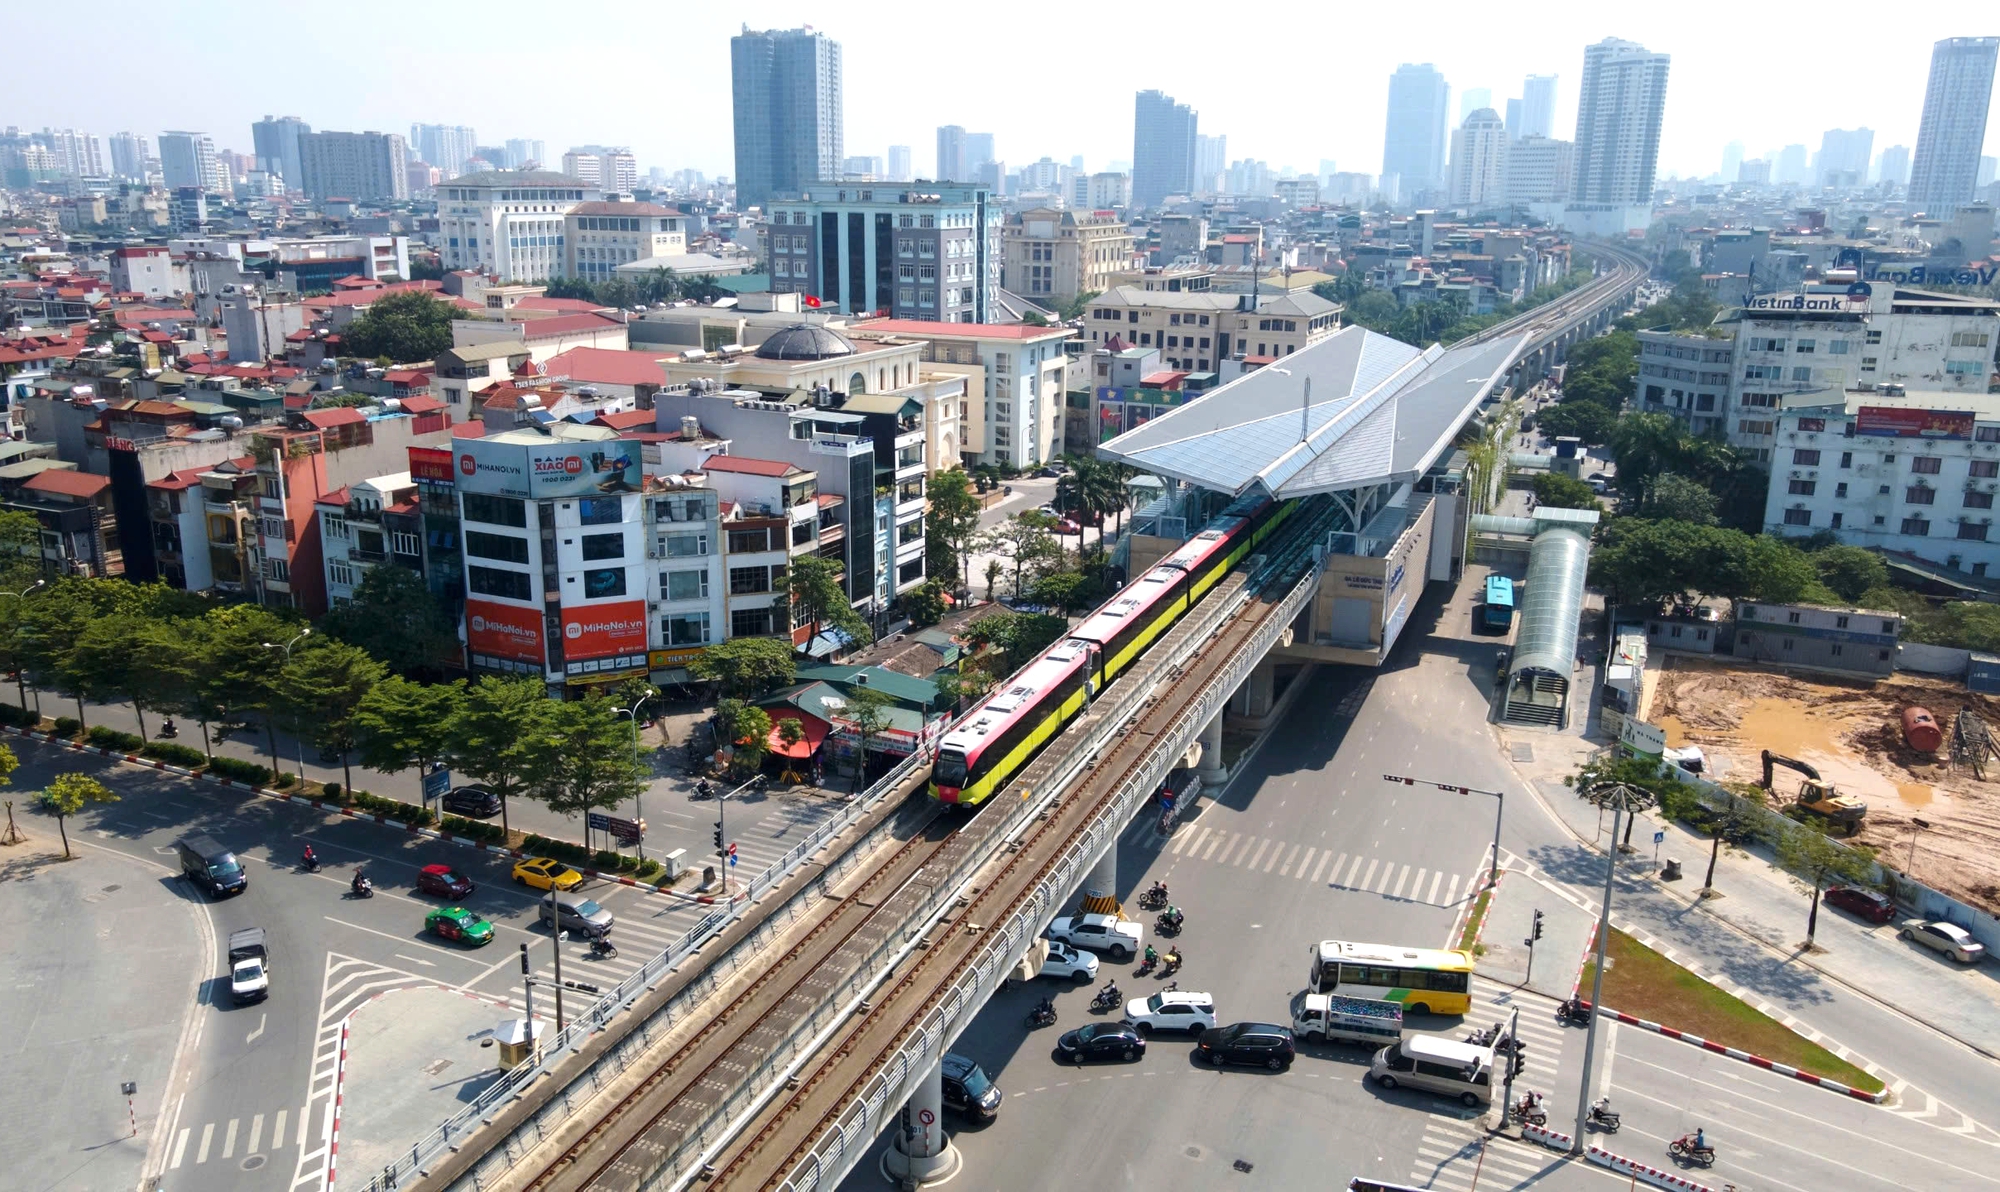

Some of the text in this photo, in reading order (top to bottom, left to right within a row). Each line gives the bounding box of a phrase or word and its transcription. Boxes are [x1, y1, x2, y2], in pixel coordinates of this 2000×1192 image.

[1742, 294, 1842, 310] VietinBank
[535, 462, 564, 471] XIAO
[485, 621, 537, 638] MiHaNoi.vn
[583, 620, 643, 633] MiHaNoi.vn
